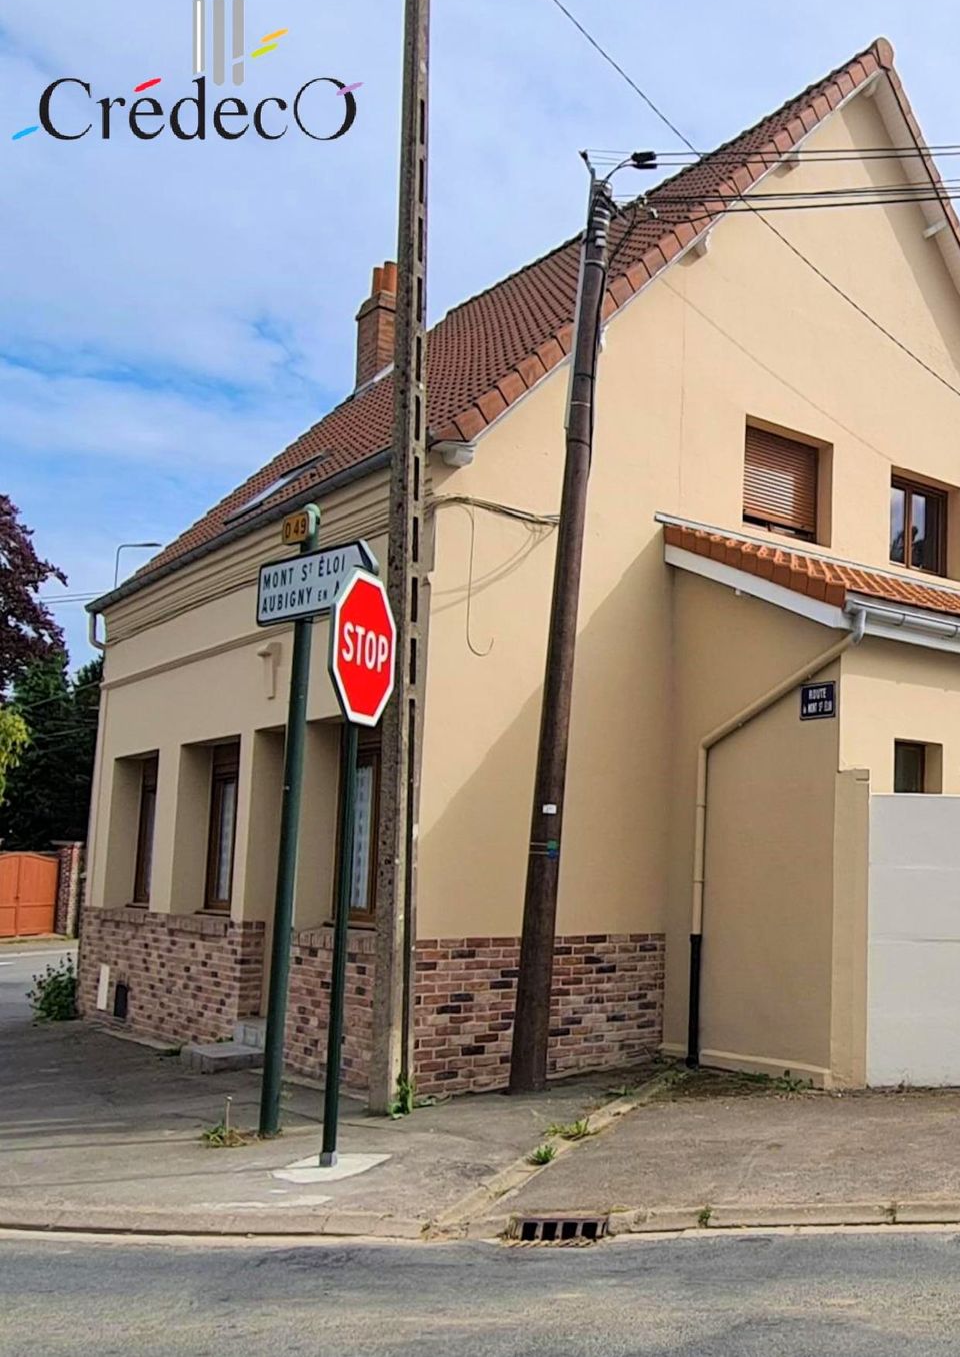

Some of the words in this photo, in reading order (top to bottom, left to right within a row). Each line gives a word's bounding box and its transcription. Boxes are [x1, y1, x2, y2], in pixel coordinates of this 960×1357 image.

[293, 518, 307, 535] 49
[263, 567, 294, 591] MONT
[318, 554, 346, 578] ÉLOI
[261, 587, 313, 614] AUBIGNY
[341, 621, 389, 673] STOP
[808, 687, 827, 700] ROUTE
